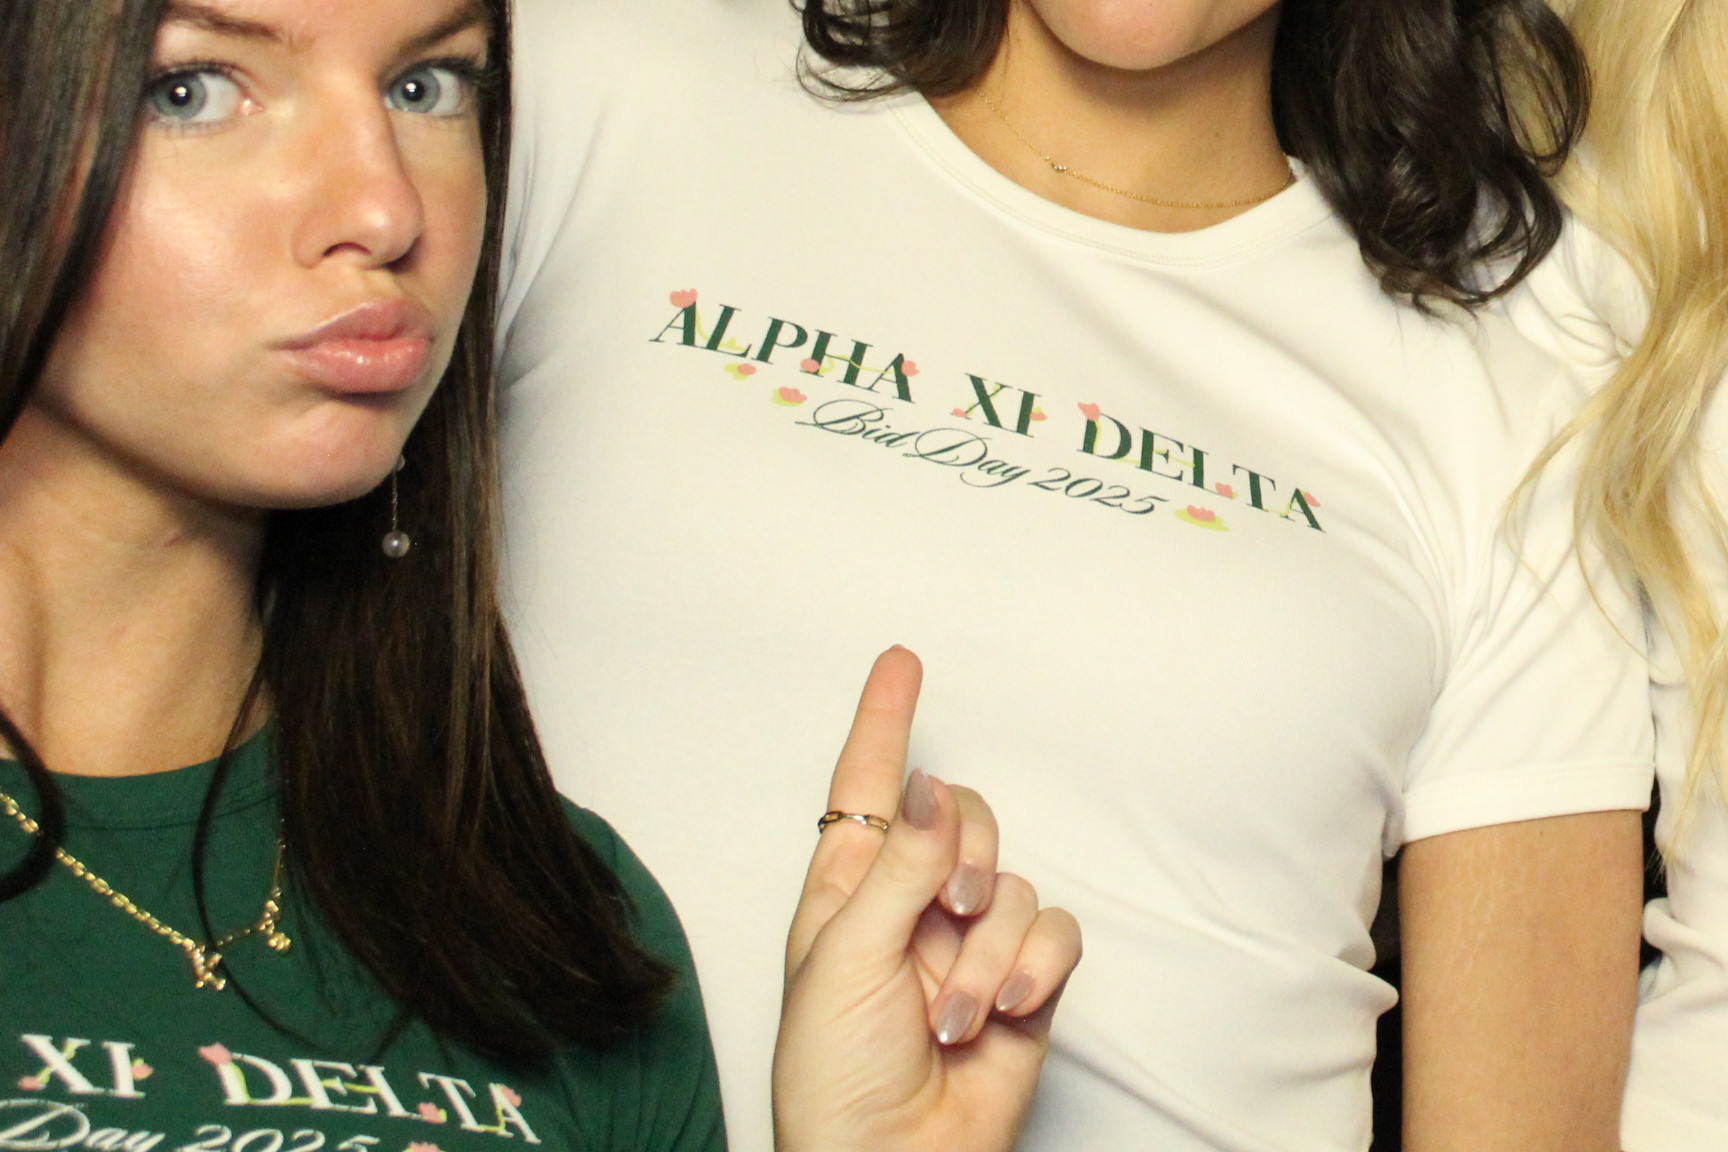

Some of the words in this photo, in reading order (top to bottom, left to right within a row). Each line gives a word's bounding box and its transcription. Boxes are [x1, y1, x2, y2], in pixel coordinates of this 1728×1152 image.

[648, 300, 917, 404] ALPHA
[950, 372, 1046, 438] XI
[1076, 410, 1326, 533] DELTA
[794, 398, 920, 450] Bid
[901, 427, 1031, 488] Day
[1027, 466, 1169, 515] 2025
[18, 1033, 145, 1097] XI
[218, 1051, 541, 1144] DELTA
